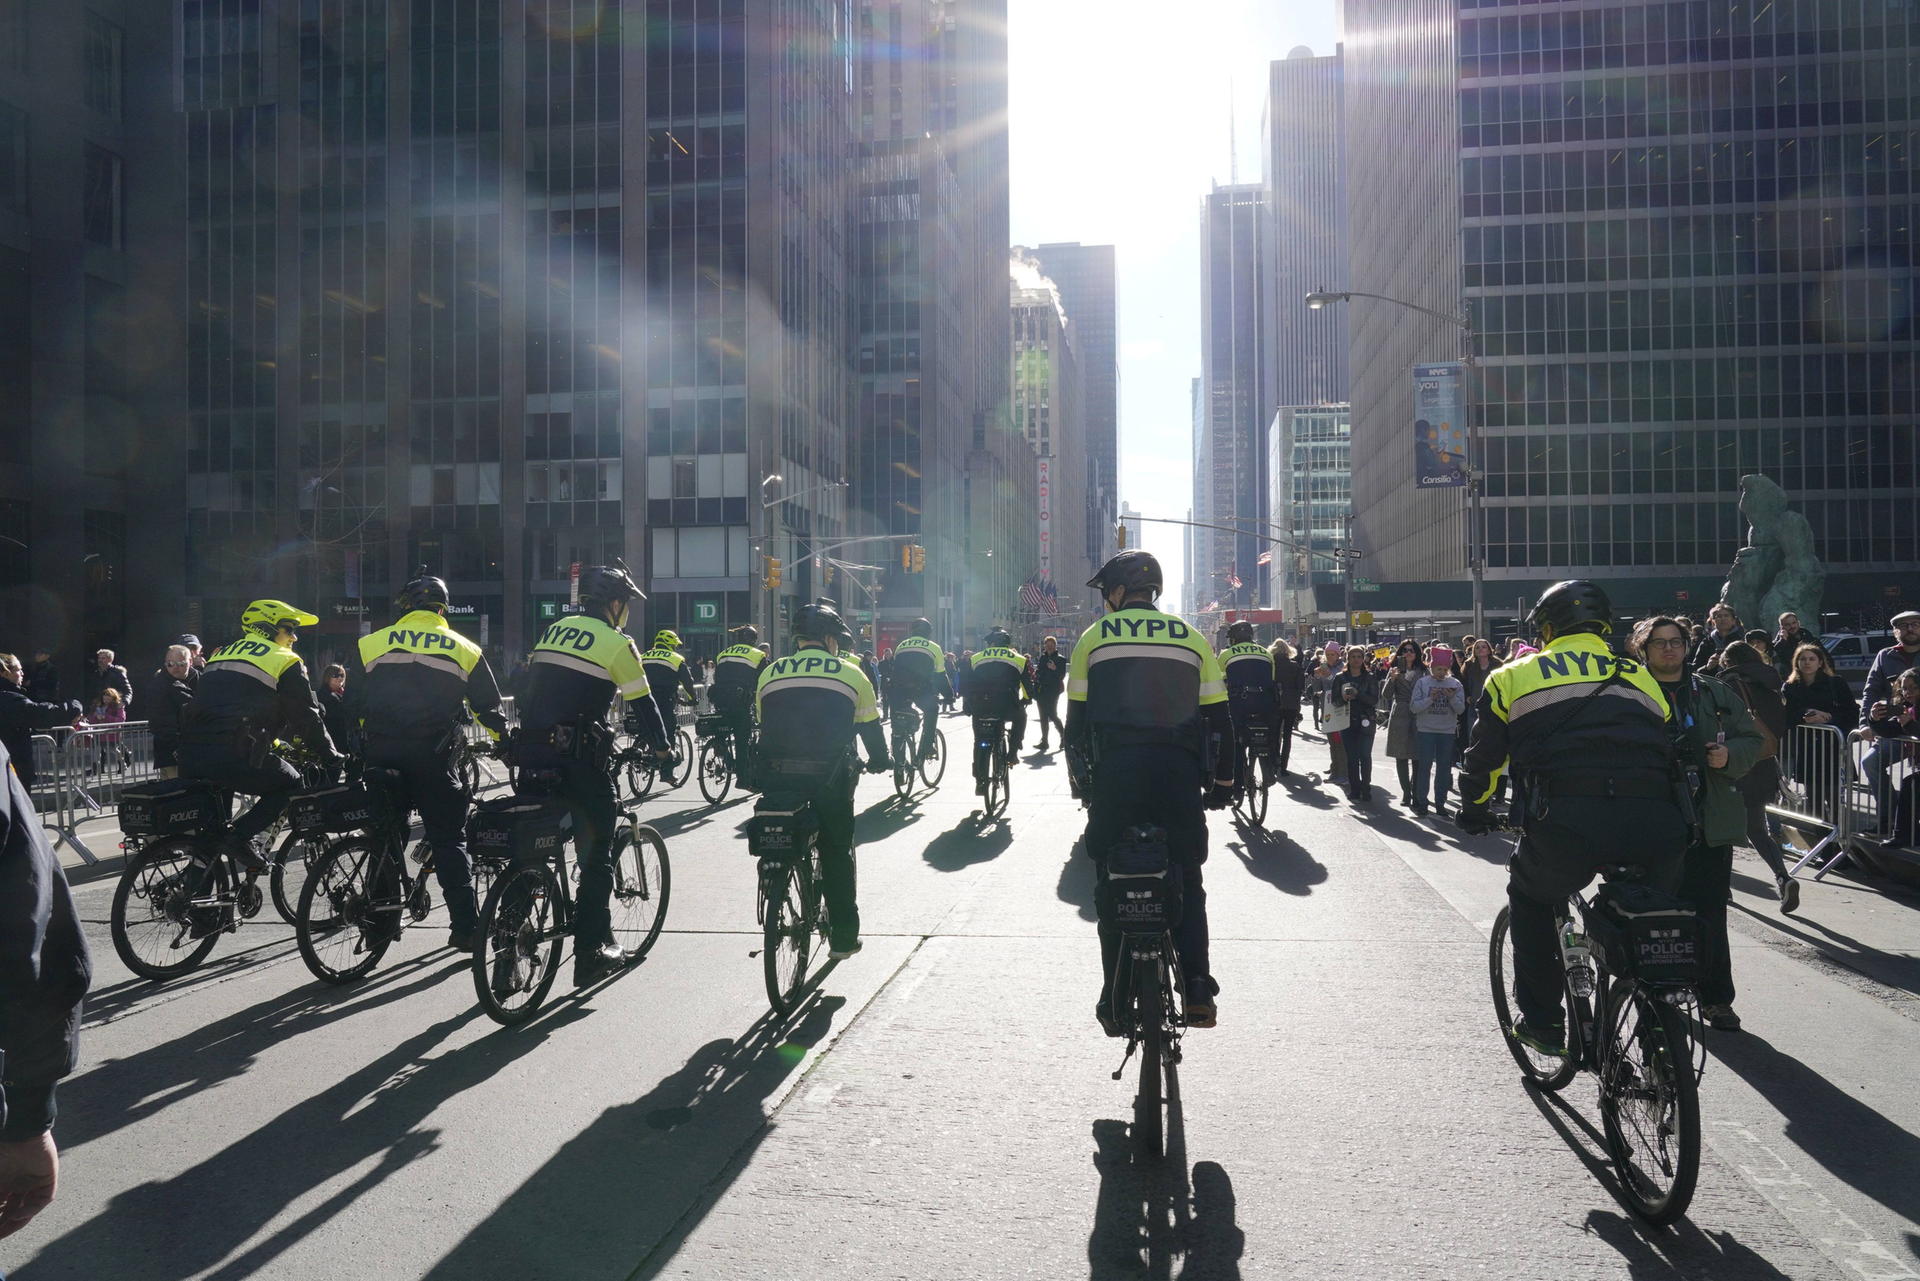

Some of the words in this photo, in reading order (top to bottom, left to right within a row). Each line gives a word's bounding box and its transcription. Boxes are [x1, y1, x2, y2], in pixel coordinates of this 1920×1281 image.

[1429, 368, 1448, 376] NYC
[1418, 382, 1438, 392] you
[1040, 462, 1049, 520] RADIO
[1040, 531, 1049, 578] CITY
[448, 605, 475, 614] Bank
[696, 603, 716, 618] TD
[1101, 618, 1189, 639] NYPD
[388, 630, 456, 650] NYPD
[537, 625, 595, 651] NYPD
[901, 639, 929, 647] NYPD
[214, 641, 271, 657] NYPD
[643, 649, 672, 658] NYPD
[723, 645, 750, 654] NYPD
[983, 649, 1015, 659] NYPD
[1232, 646, 1267, 655] NYPD
[769, 657, 842, 677] NYPD
[1537, 651, 1638, 680] NYPD
[169, 809, 200, 824] POLICE
[343, 809, 369, 821] POLICE
[476, 832, 509, 840] POLICE
[535, 835, 556, 849] POLICE
[1118, 904, 1163, 913] POLICE
[1641, 943, 1695, 955] POLICE
